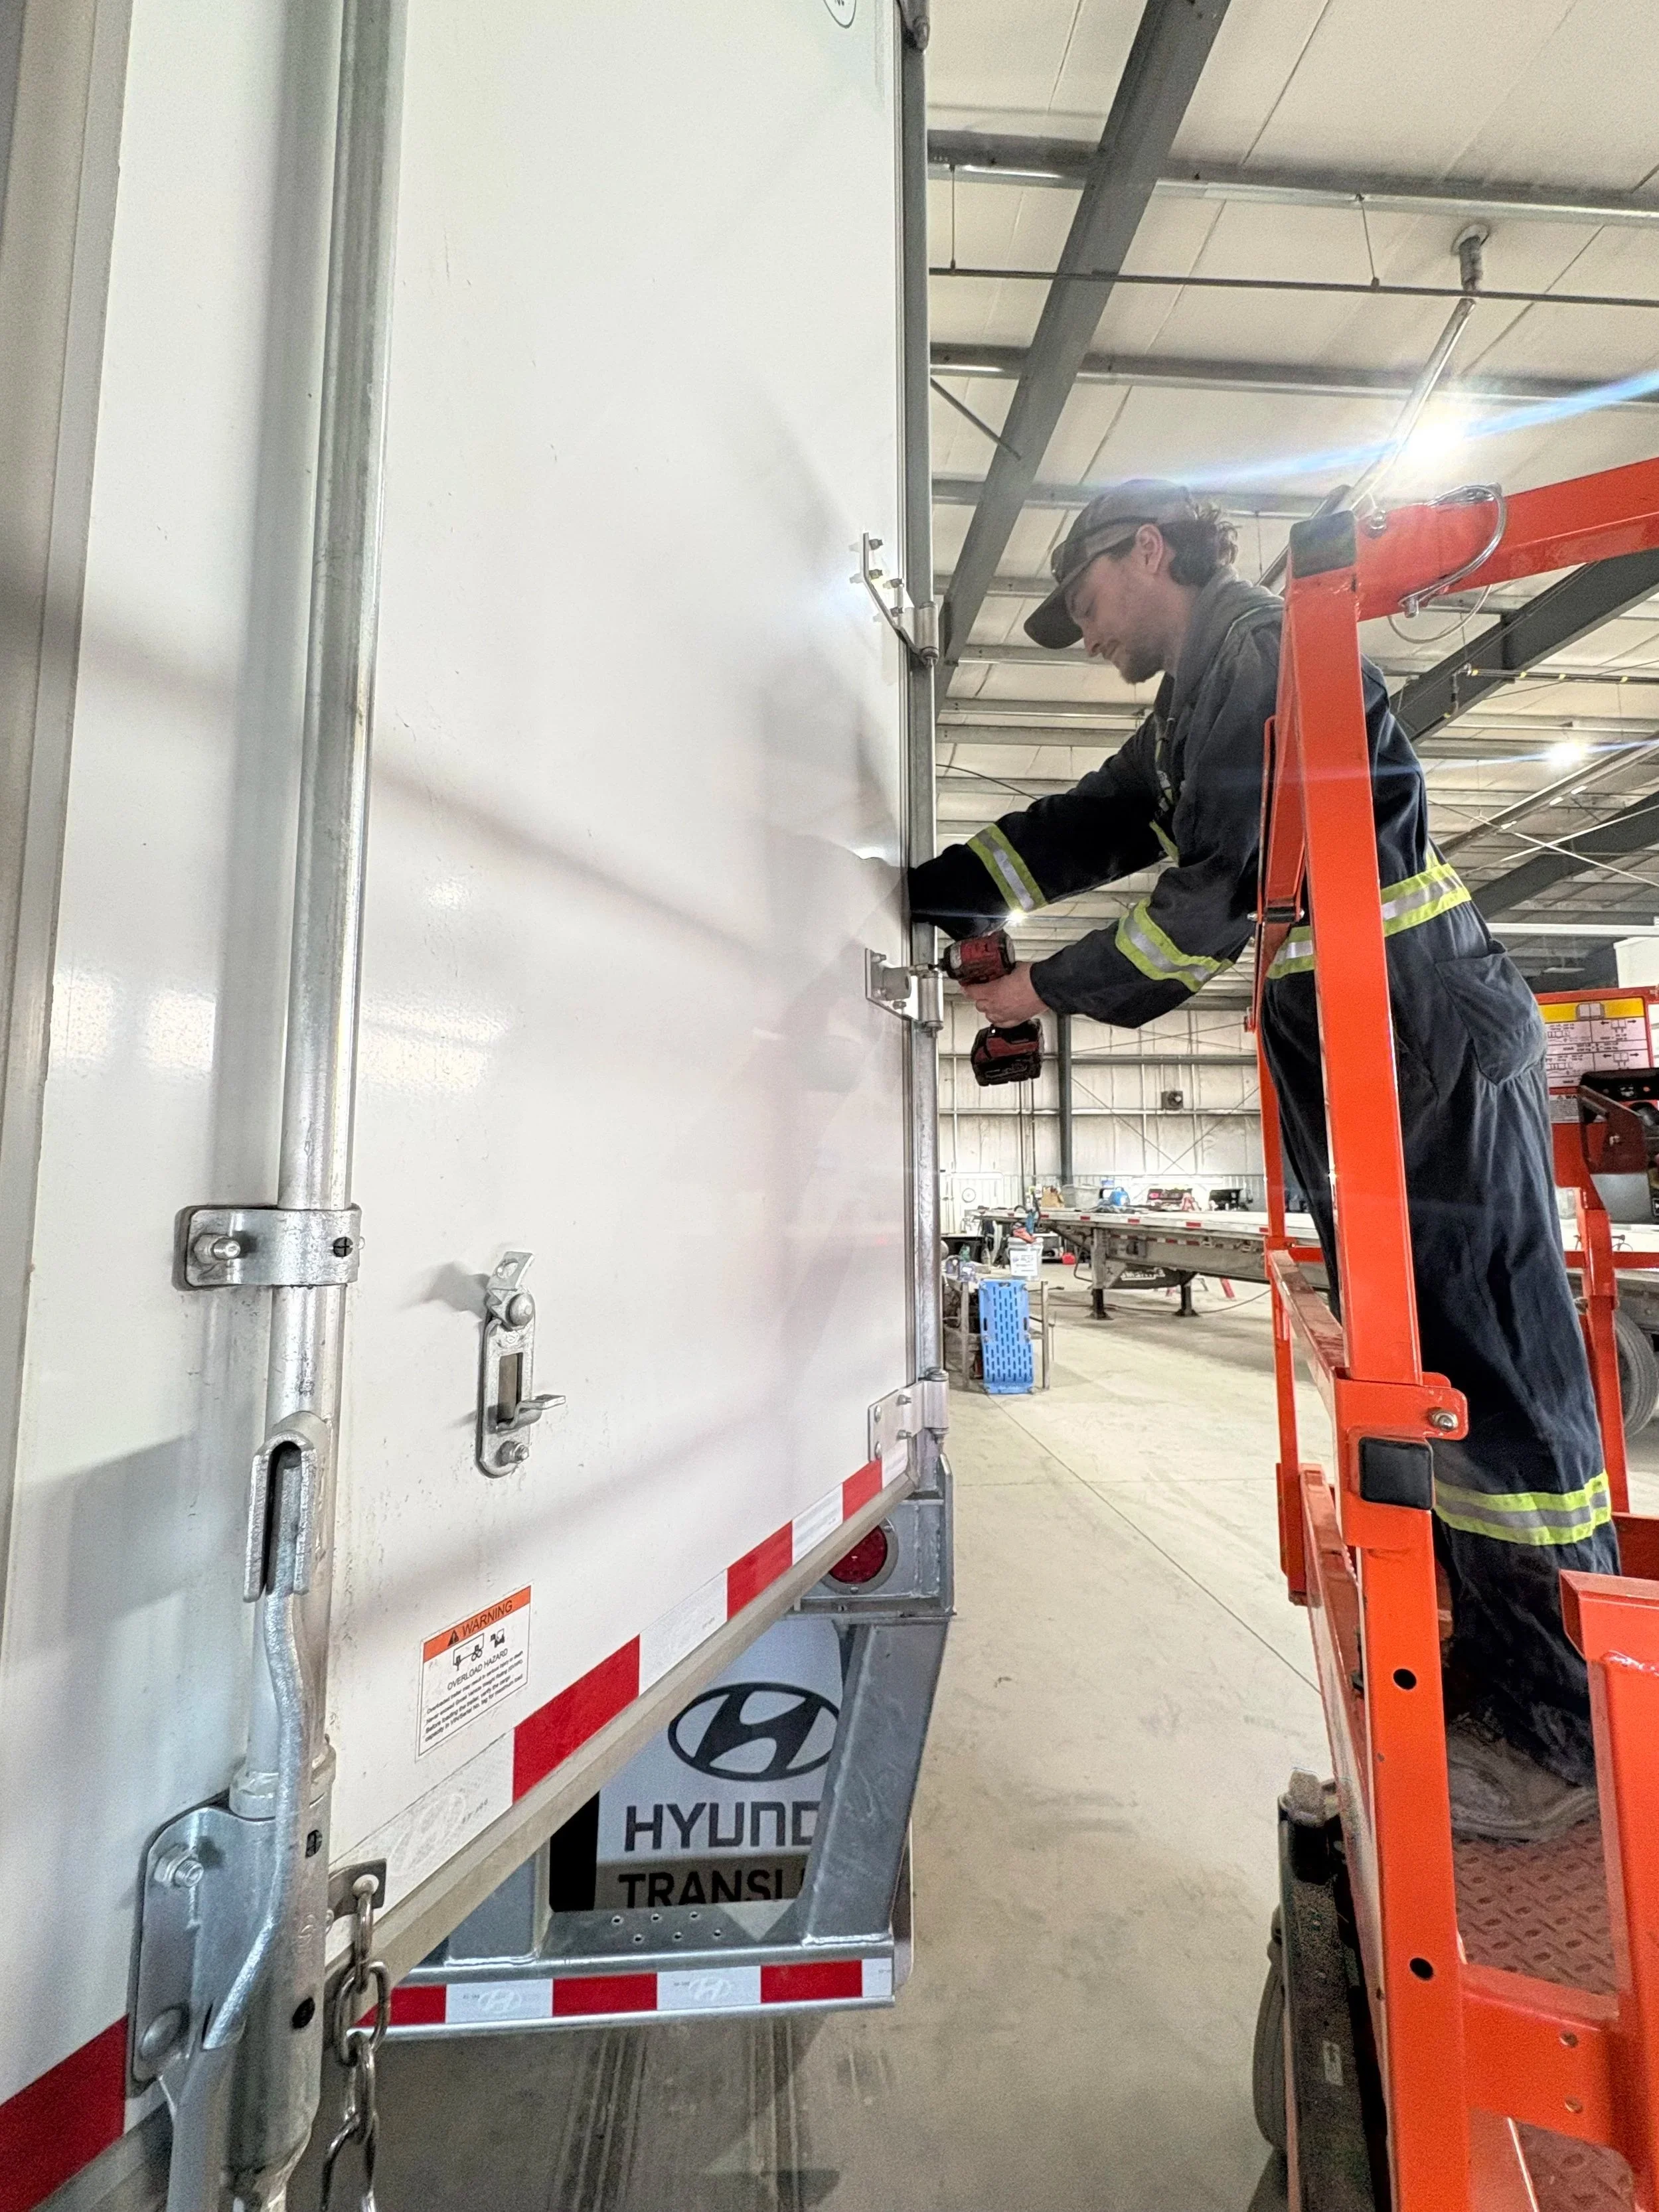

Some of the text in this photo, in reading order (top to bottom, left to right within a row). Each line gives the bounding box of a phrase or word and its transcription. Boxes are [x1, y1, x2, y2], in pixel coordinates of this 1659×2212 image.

[462, 1600, 513, 1637] WARNING
[447, 1648, 508, 1690] OVERLOAD HAZARD
